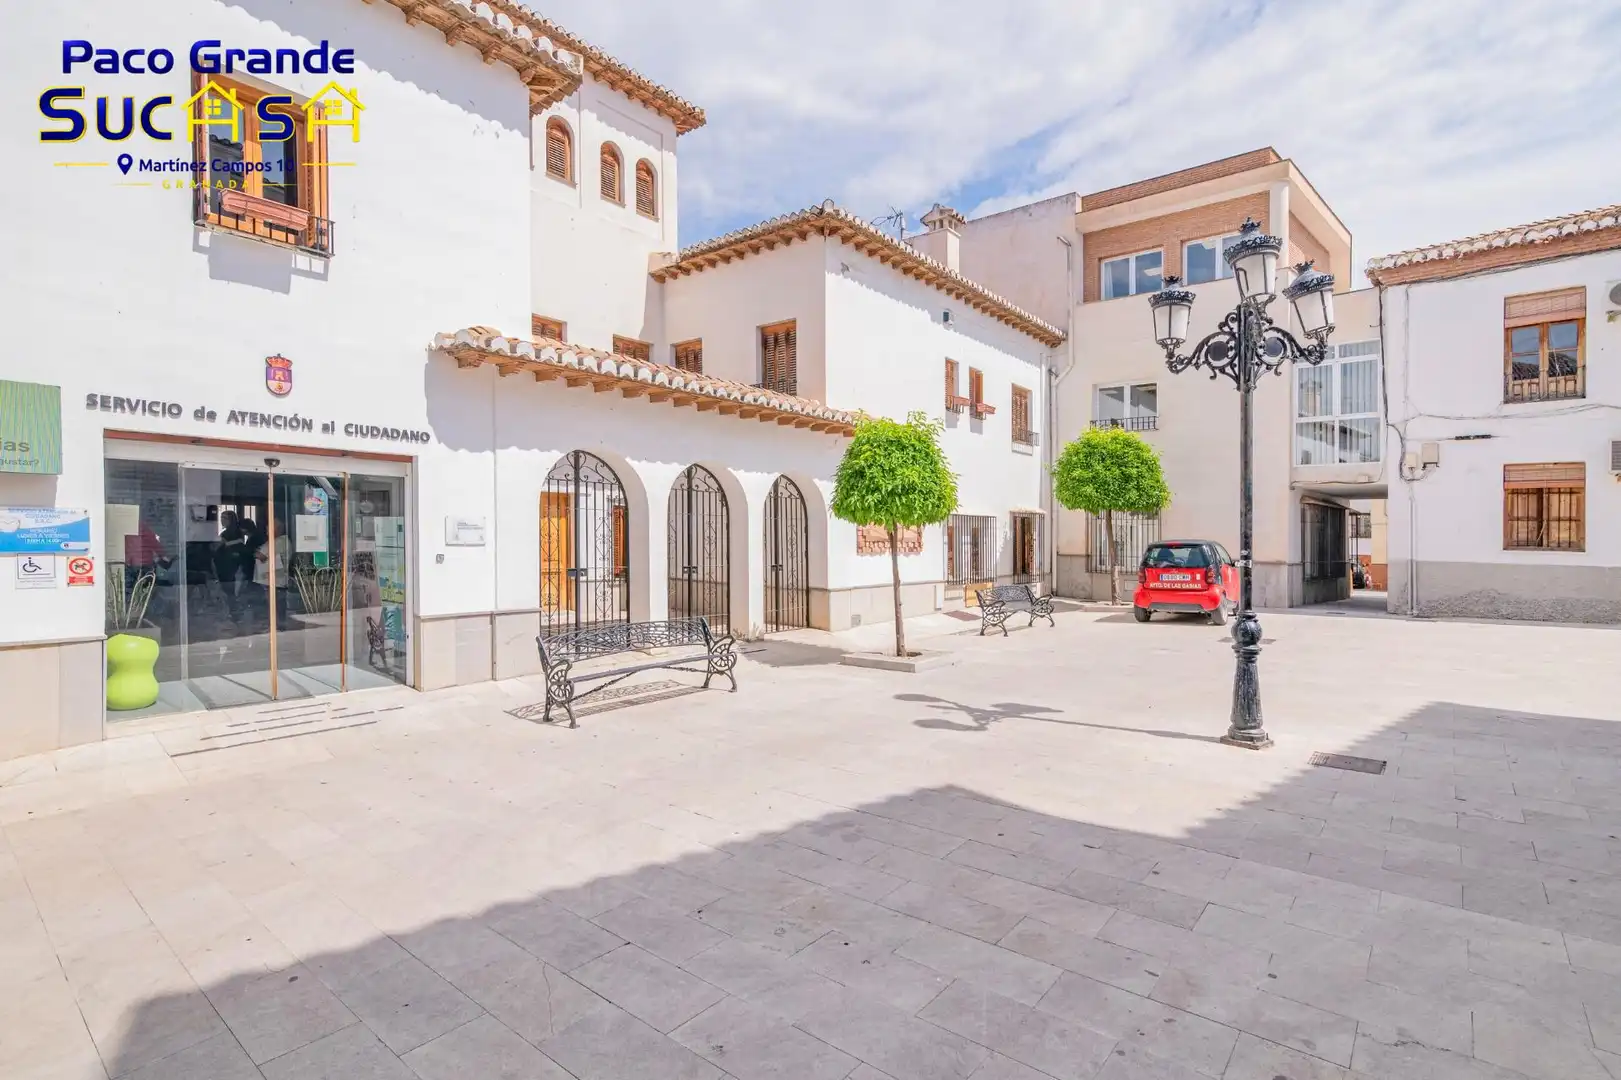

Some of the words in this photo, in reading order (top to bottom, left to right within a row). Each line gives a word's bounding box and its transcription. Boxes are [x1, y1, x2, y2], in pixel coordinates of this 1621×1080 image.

[86, 393, 182, 419] SERVICIO
[193, 406, 217, 422] de
[227, 409, 313, 432] ATENCIÓN
[321, 421, 335, 434] al
[344, 423, 430, 443] CIUDADANO
